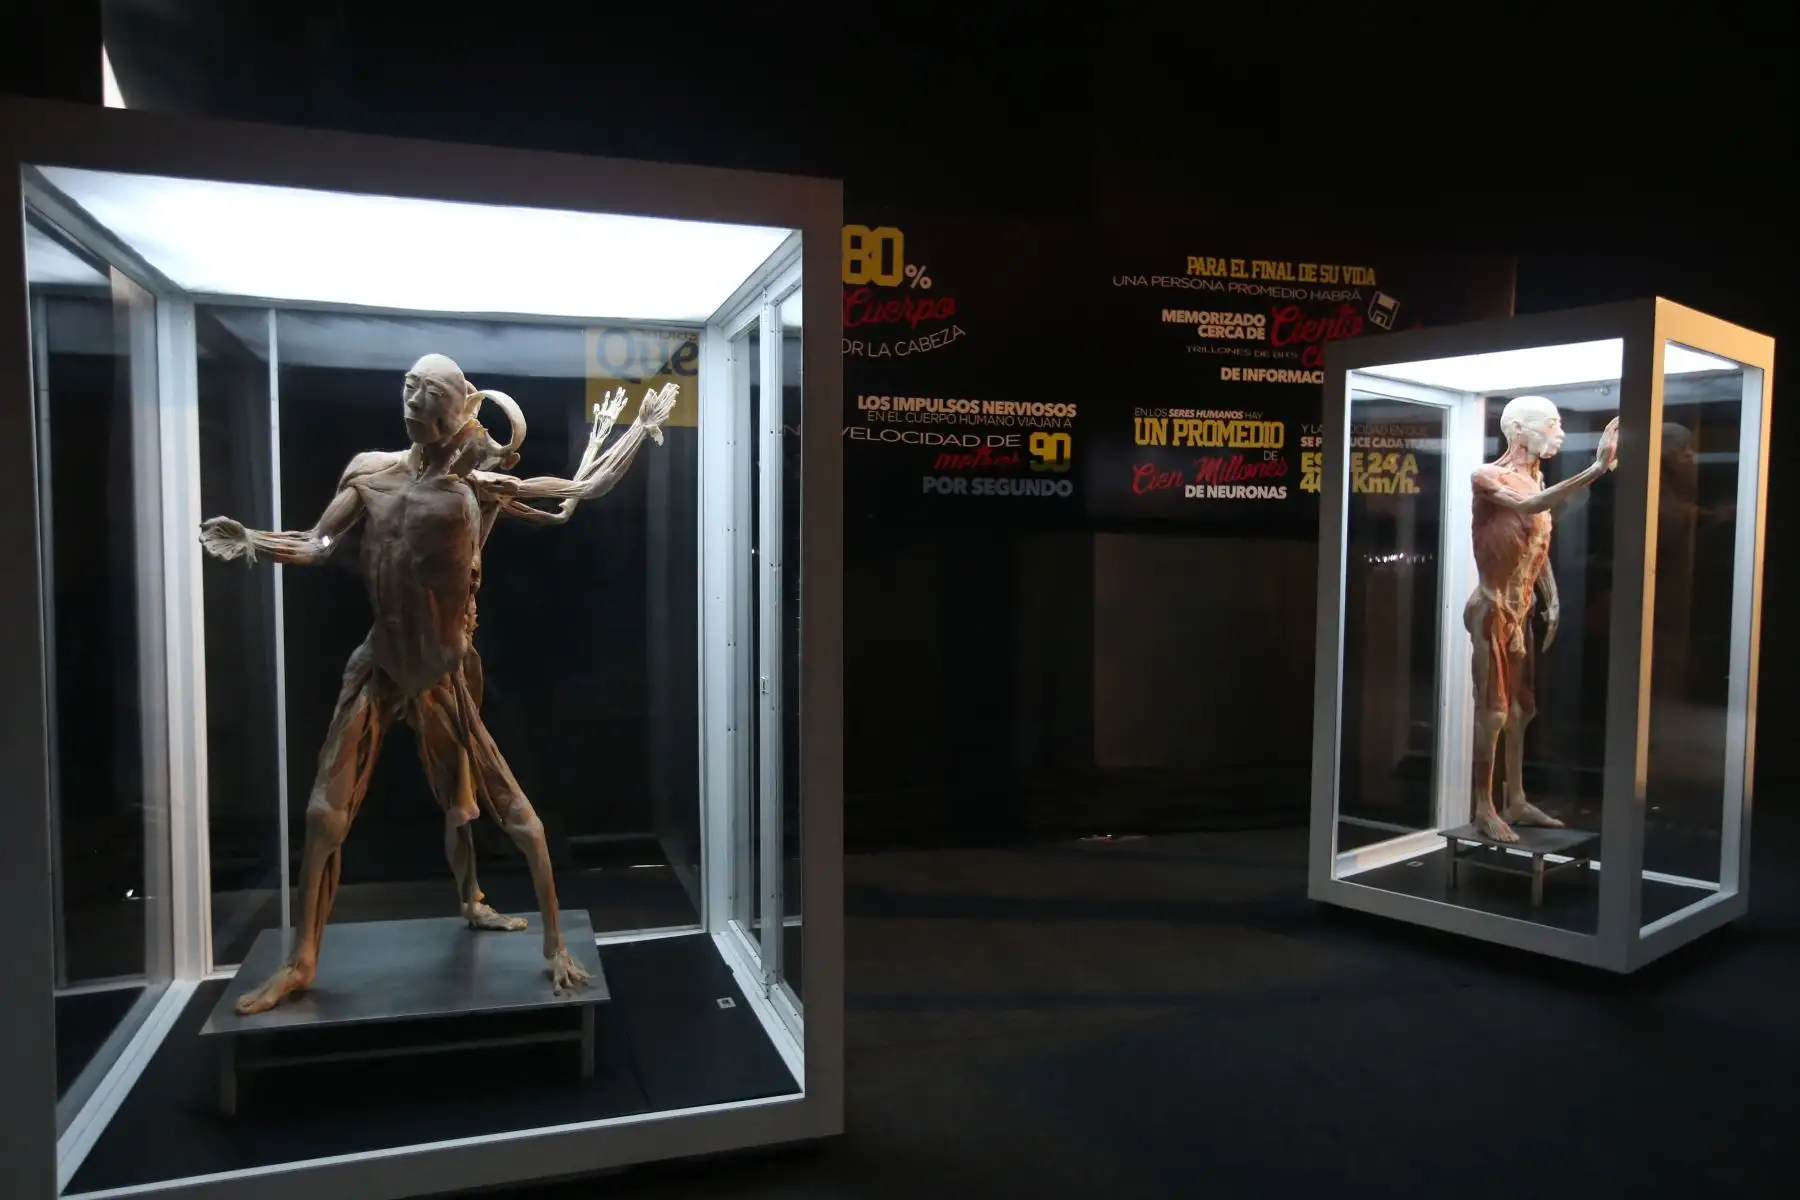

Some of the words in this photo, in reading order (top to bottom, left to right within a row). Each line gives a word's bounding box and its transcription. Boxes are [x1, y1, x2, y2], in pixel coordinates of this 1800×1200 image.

[1187, 256, 1227, 277] PARA
[1230, 258, 1249, 278] EL
[1251, 260, 1295, 281] FINAL
[1298, 263, 1319, 283] DE
[1320, 264, 1341, 284] SU
[1343, 265, 1376, 286] VIDA
[1113, 275, 1148, 288] UNA
[1152, 276, 1224, 292] PERSONA
[1228, 282, 1307, 300] PROMEDIO
[842, 287, 957, 329] Cuerpo
[1162, 308, 1266, 327] MEMORIZADO
[841, 338, 864, 356] OR
[868, 342, 891, 358] LA
[895, 324, 966, 357] CABEZA
[1197, 325, 1244, 340] CERCA
[1247, 326, 1266, 341] DE
[596, 328, 699, 384] Que
[1220, 366, 1241, 382] DE
[1243, 367, 1324, 384] INFORMACI
[858, 395, 891, 411] LOS
[893, 396, 980, 414] IMPULSOS
[982, 400, 1077, 418] NERVIOSOS
[1134, 407, 1150, 417] EN
[1150, 407, 1168, 418] LOS
[1168, 408, 1195, 419] SERES
[1196, 409, 1244, 420] HUMANOS
[1245, 411, 1264, 420] HAY
[867, 411, 885, 422] EN
[888, 412, 903, 423] EL
[905, 412, 957, 425] CUERPO
[959, 415, 1015, 427] HUMANO
[1017, 416, 1061, 428] VIAJAN
[1063, 418, 1073, 428] A
[1300, 423, 1309, 434] Y
[1134, 417, 1169, 447] UN
[1172, 418, 1285, 449] PROMEDIO
[1300, 436, 1314, 447] SE
[1372, 437, 1404, 448] CADA
[987, 434, 1021, 448] DE
[1029, 431, 1072, 473] 90
[1264, 450, 1279, 461] DE
[1131, 462, 1184, 495] Cien
[1193, 452, 1290, 487] Millones
[1400, 453, 1420, 474] A
[922, 476, 967, 495] POR
[971, 477, 1073, 497] SEGUNDO
[1184, 484, 1206, 499] DE
[1206, 485, 1288, 500] NEURONAS
